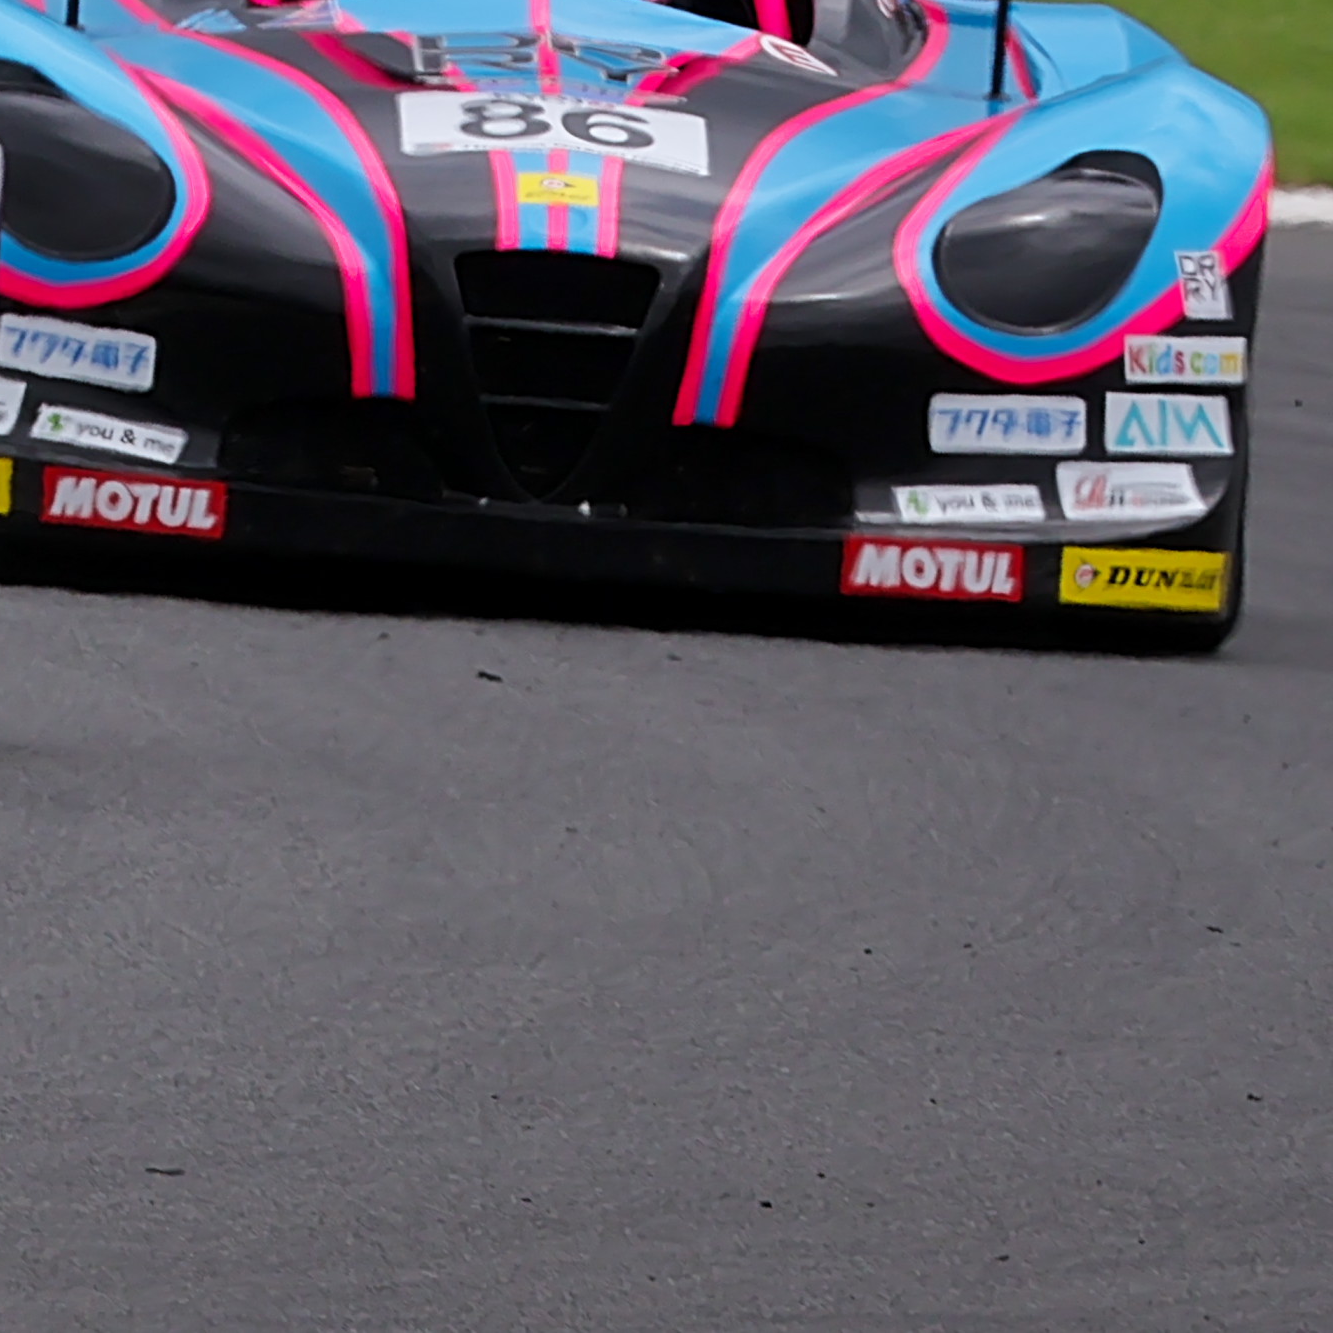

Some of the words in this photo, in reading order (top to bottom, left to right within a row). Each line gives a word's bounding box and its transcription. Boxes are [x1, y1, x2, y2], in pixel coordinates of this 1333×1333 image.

[459, 98, 655, 149] 86
[1128, 344, 1185, 376] Kids
[1189, 351, 1239, 376] com
[77, 421, 114, 441] you
[120, 429, 135, 445] &
[143, 436, 176, 454] me
[1113, 399, 1224, 448] AIM
[49, 476, 217, 530] MOTUL
[936, 495, 975, 516] you
[981, 494, 998, 511] &
[853, 543, 1018, 596] MOTUL
